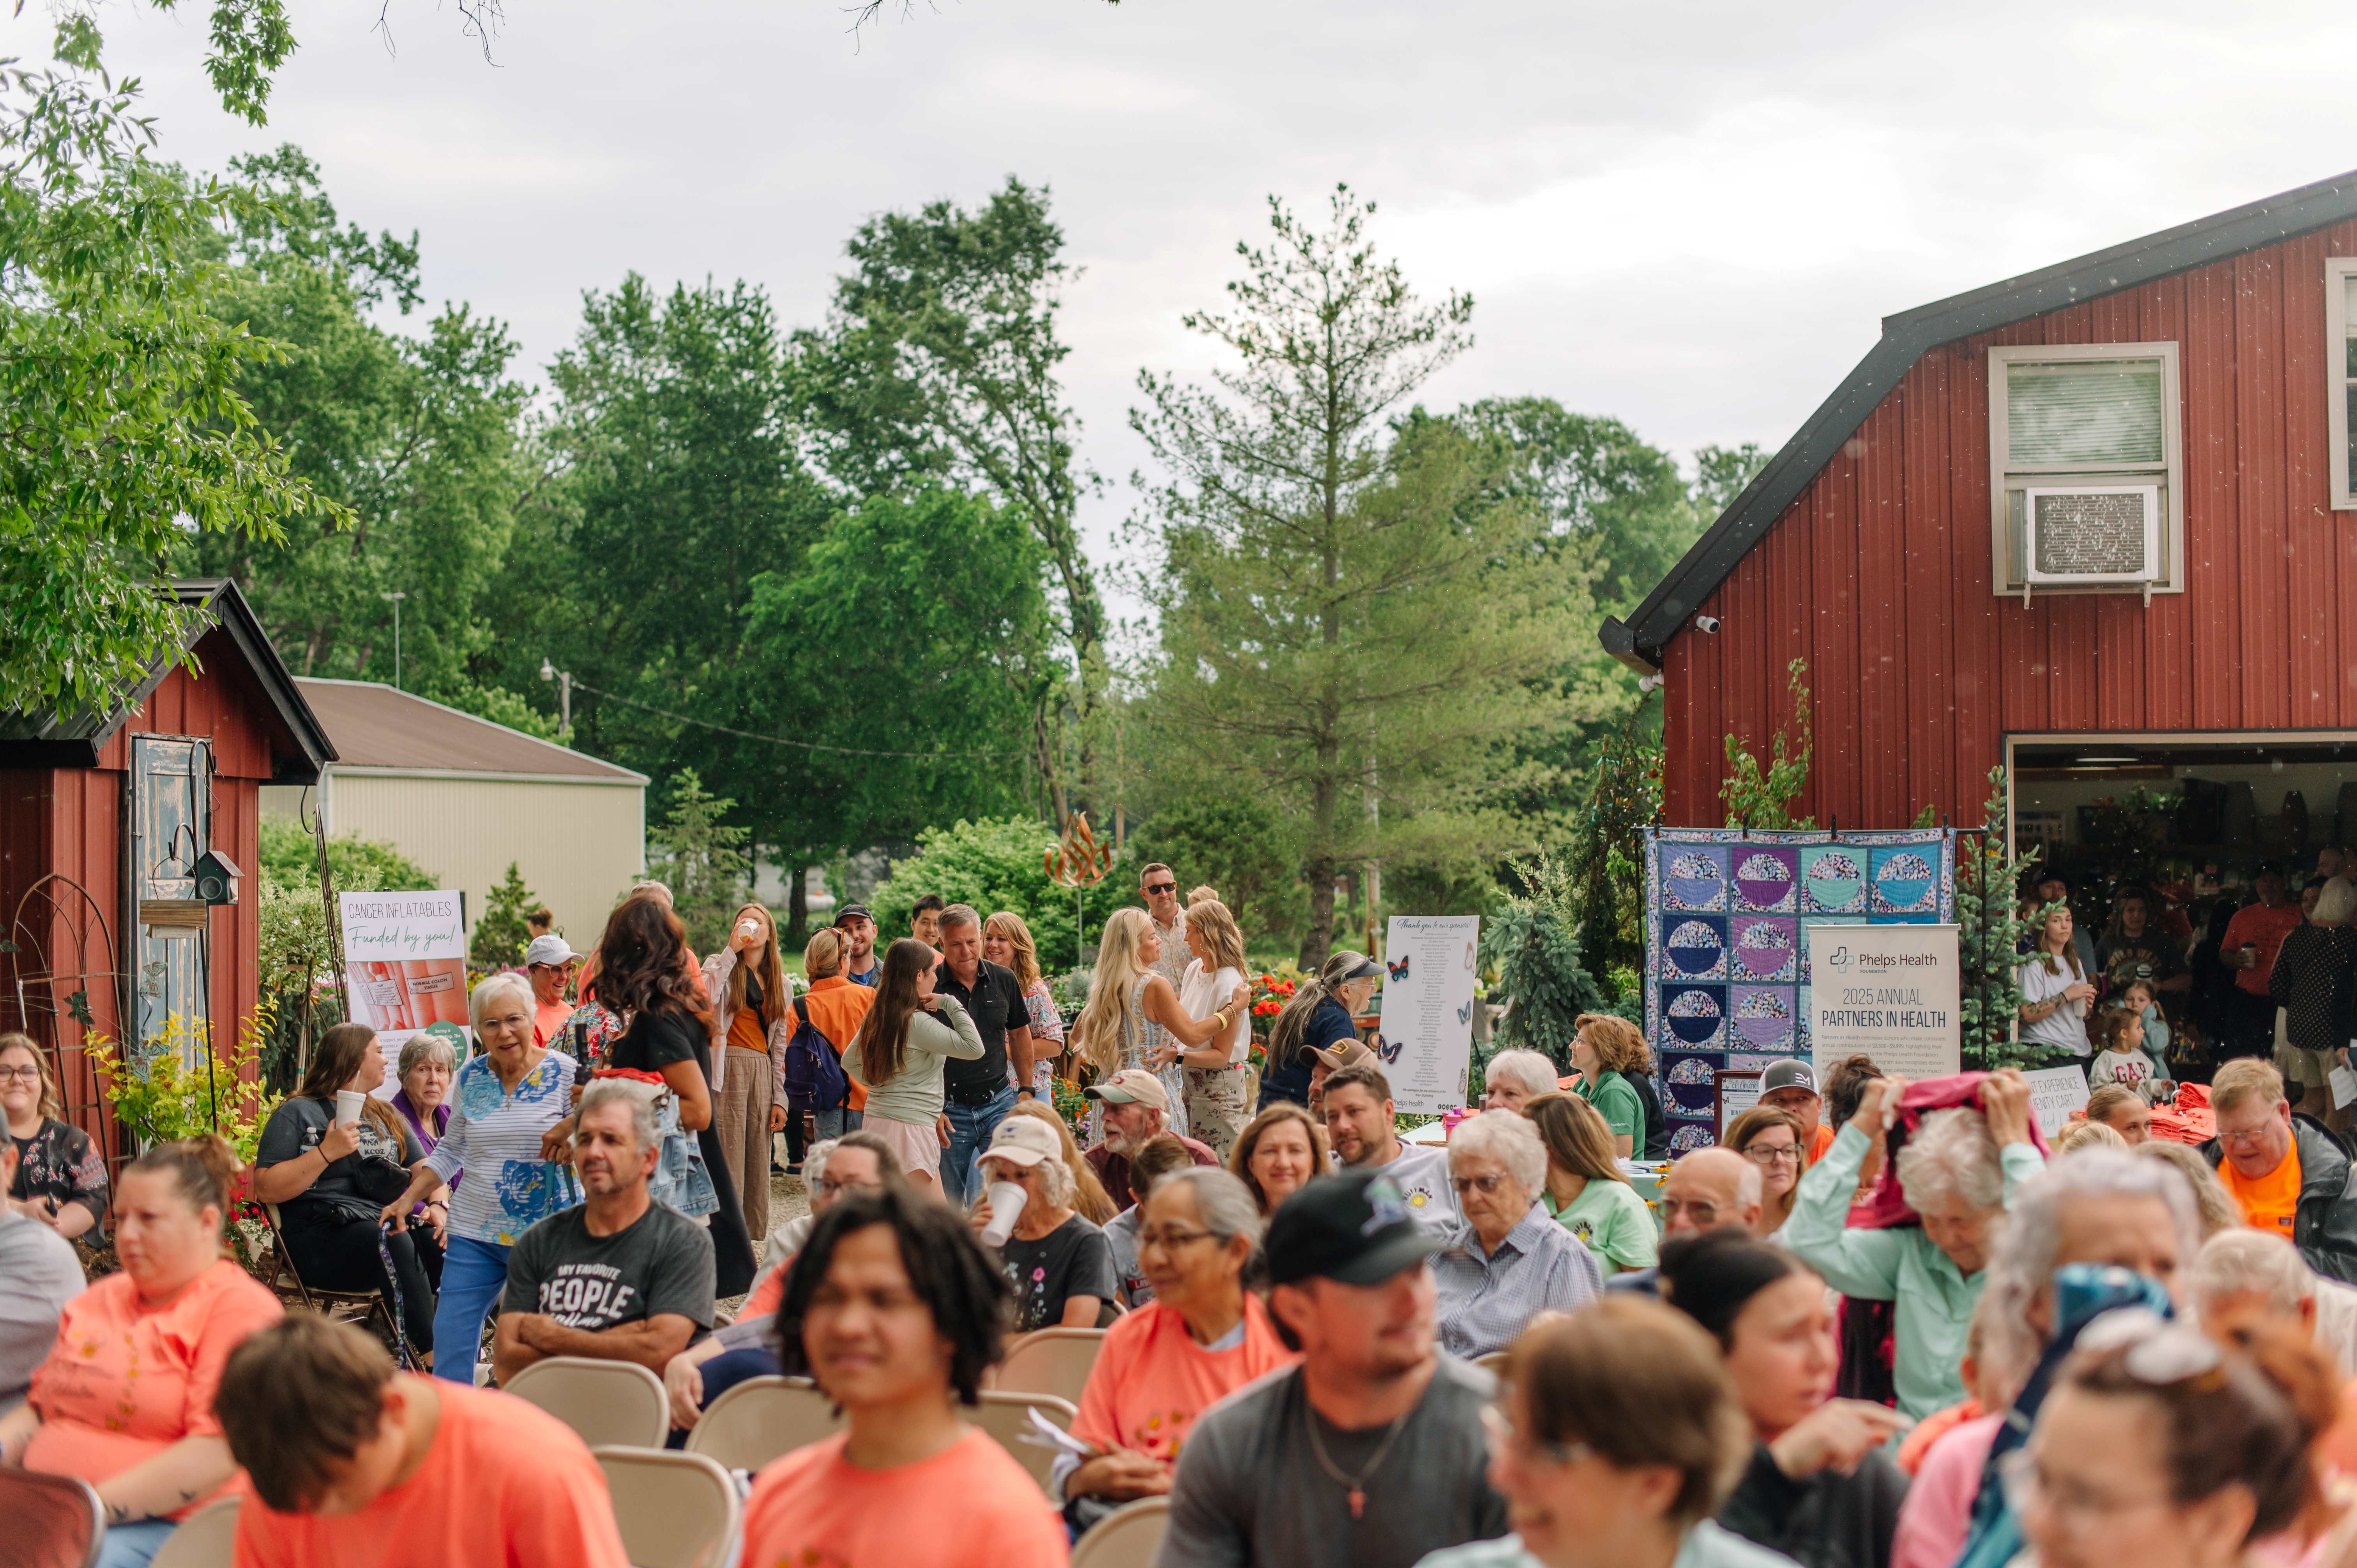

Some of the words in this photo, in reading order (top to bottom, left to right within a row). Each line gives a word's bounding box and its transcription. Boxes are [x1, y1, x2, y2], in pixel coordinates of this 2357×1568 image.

[349, 903, 383, 919] CANCER
[386, 901, 452, 918] INFLATABLES
[1397, 918, 1420, 929] Thank
[1420, 923, 1431, 933] you
[1433, 920, 1438, 929] to
[1449, 919, 1472, 931] sponsors!
[348, 926, 399, 949] Funded
[404, 925, 421, 952] by
[424, 924, 456, 952] you!
[1860, 953, 1896, 968] Phelps
[1899, 953, 1937, 966] Health
[1843, 988, 1873, 1005] 2025
[1877, 988, 1923, 1005] ANNUAL
[1822, 1010, 1882, 1027] PARTNERS
[1886, 1011, 1897, 1027] IN
[1901, 1011, 1946, 1028] HEALTH
[2115, 1062, 2147, 1083] GAP
[2038, 1076, 2080, 1093] EXPERIENCE
[2055, 1094, 2075, 1108] CART
[558, 1264, 576, 1277] MY
[576, 1263, 622, 1280] FAVORITE
[539, 1278, 635, 1319] PEOPLE
